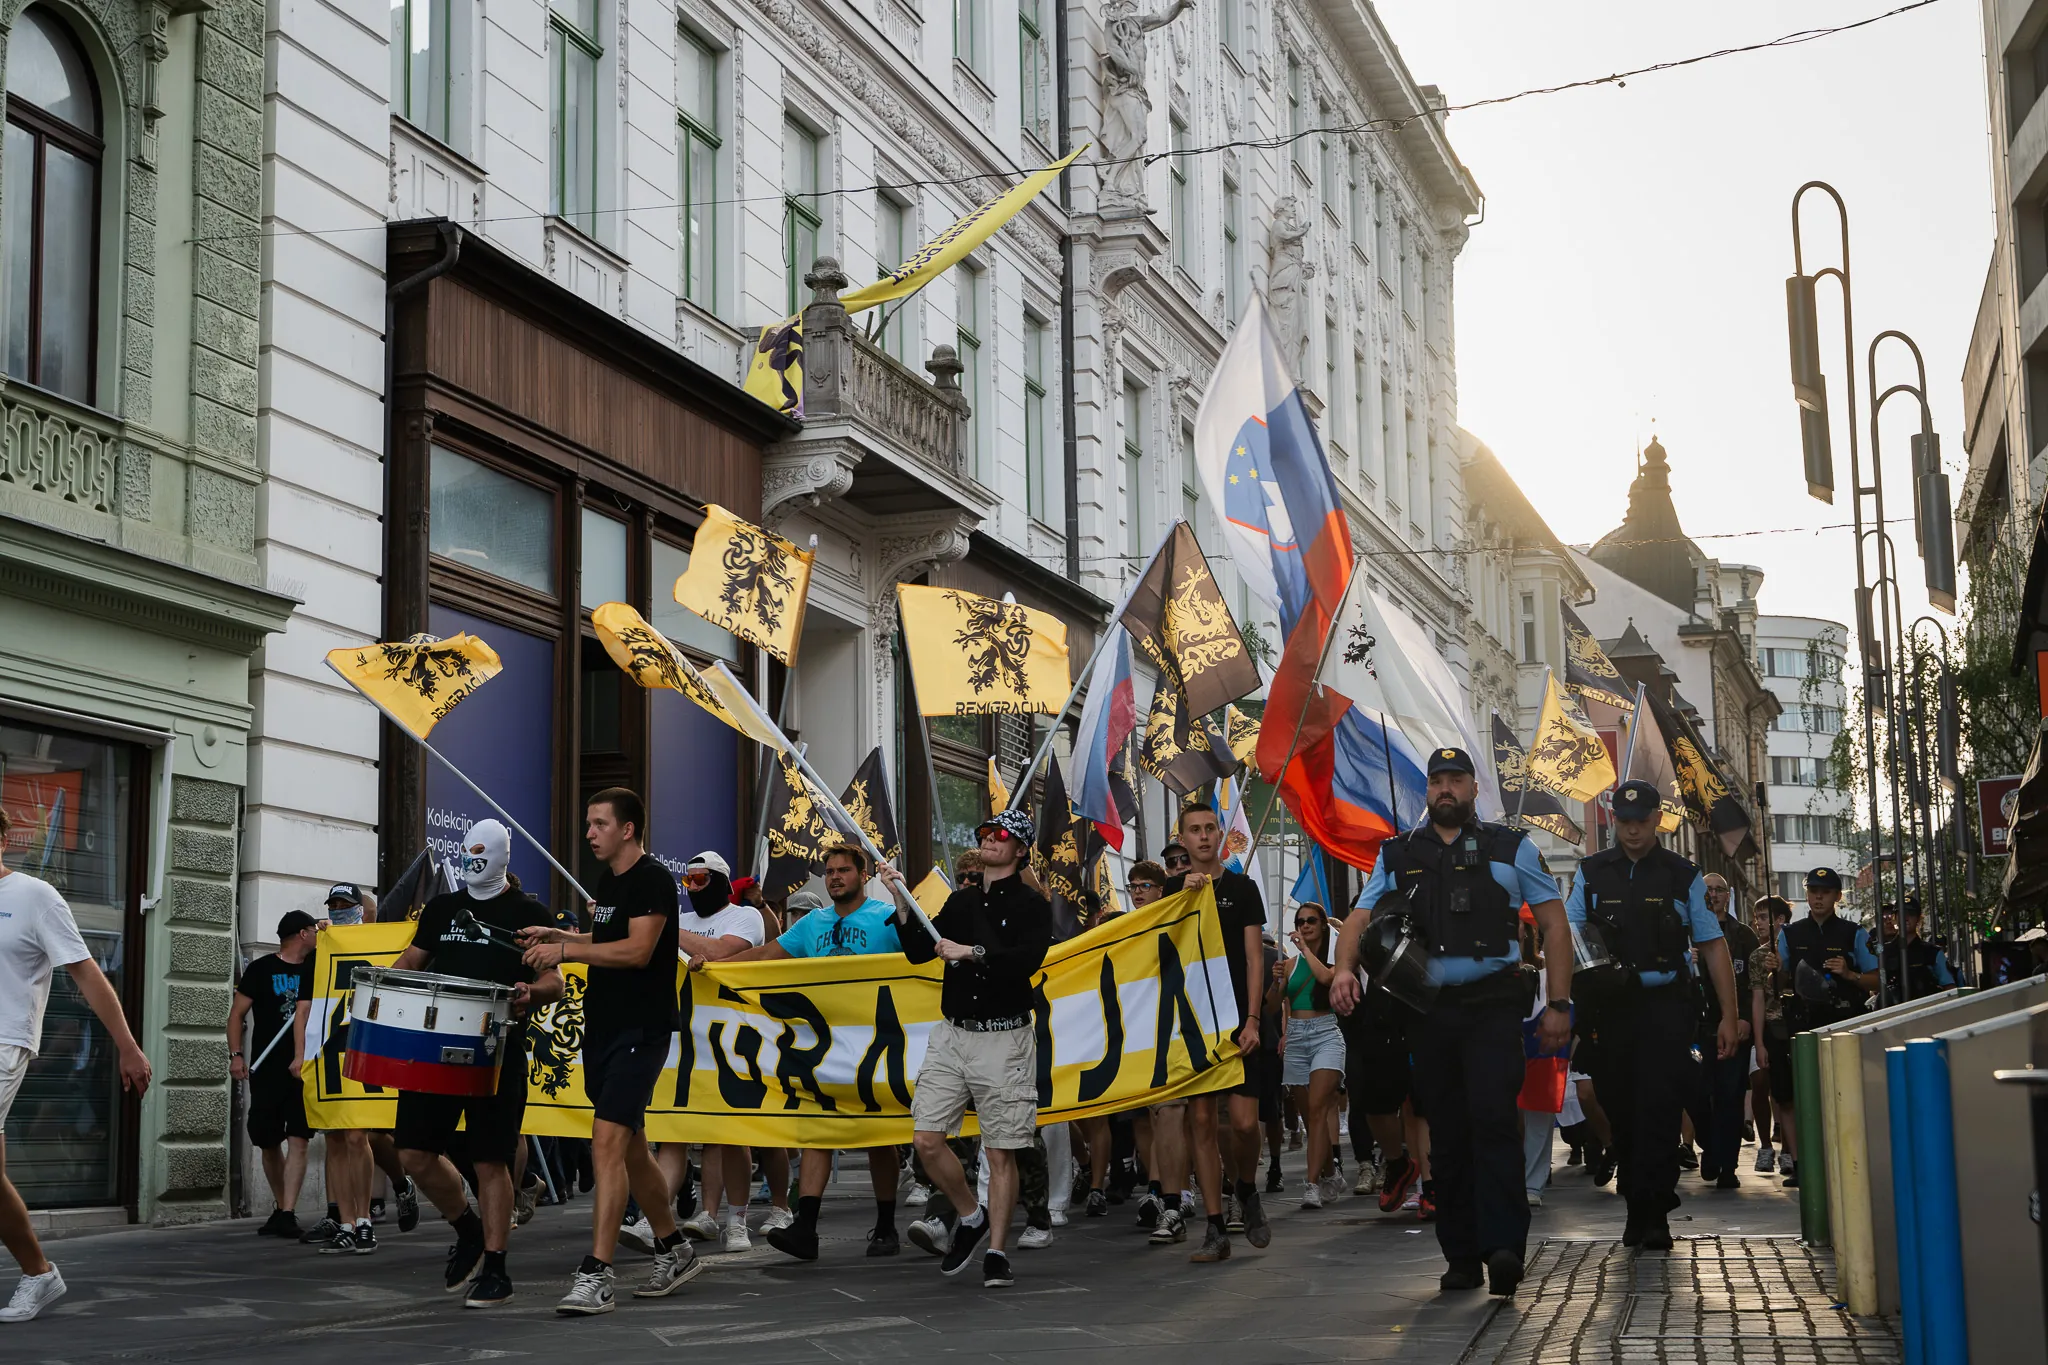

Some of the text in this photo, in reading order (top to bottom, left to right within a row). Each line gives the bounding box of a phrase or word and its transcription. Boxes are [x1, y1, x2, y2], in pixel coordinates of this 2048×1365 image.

[956, 701, 1050, 716] REMIGRACIJA
[1270, 816, 1293, 824] muej
[816, 926, 867, 953] CHMPS
